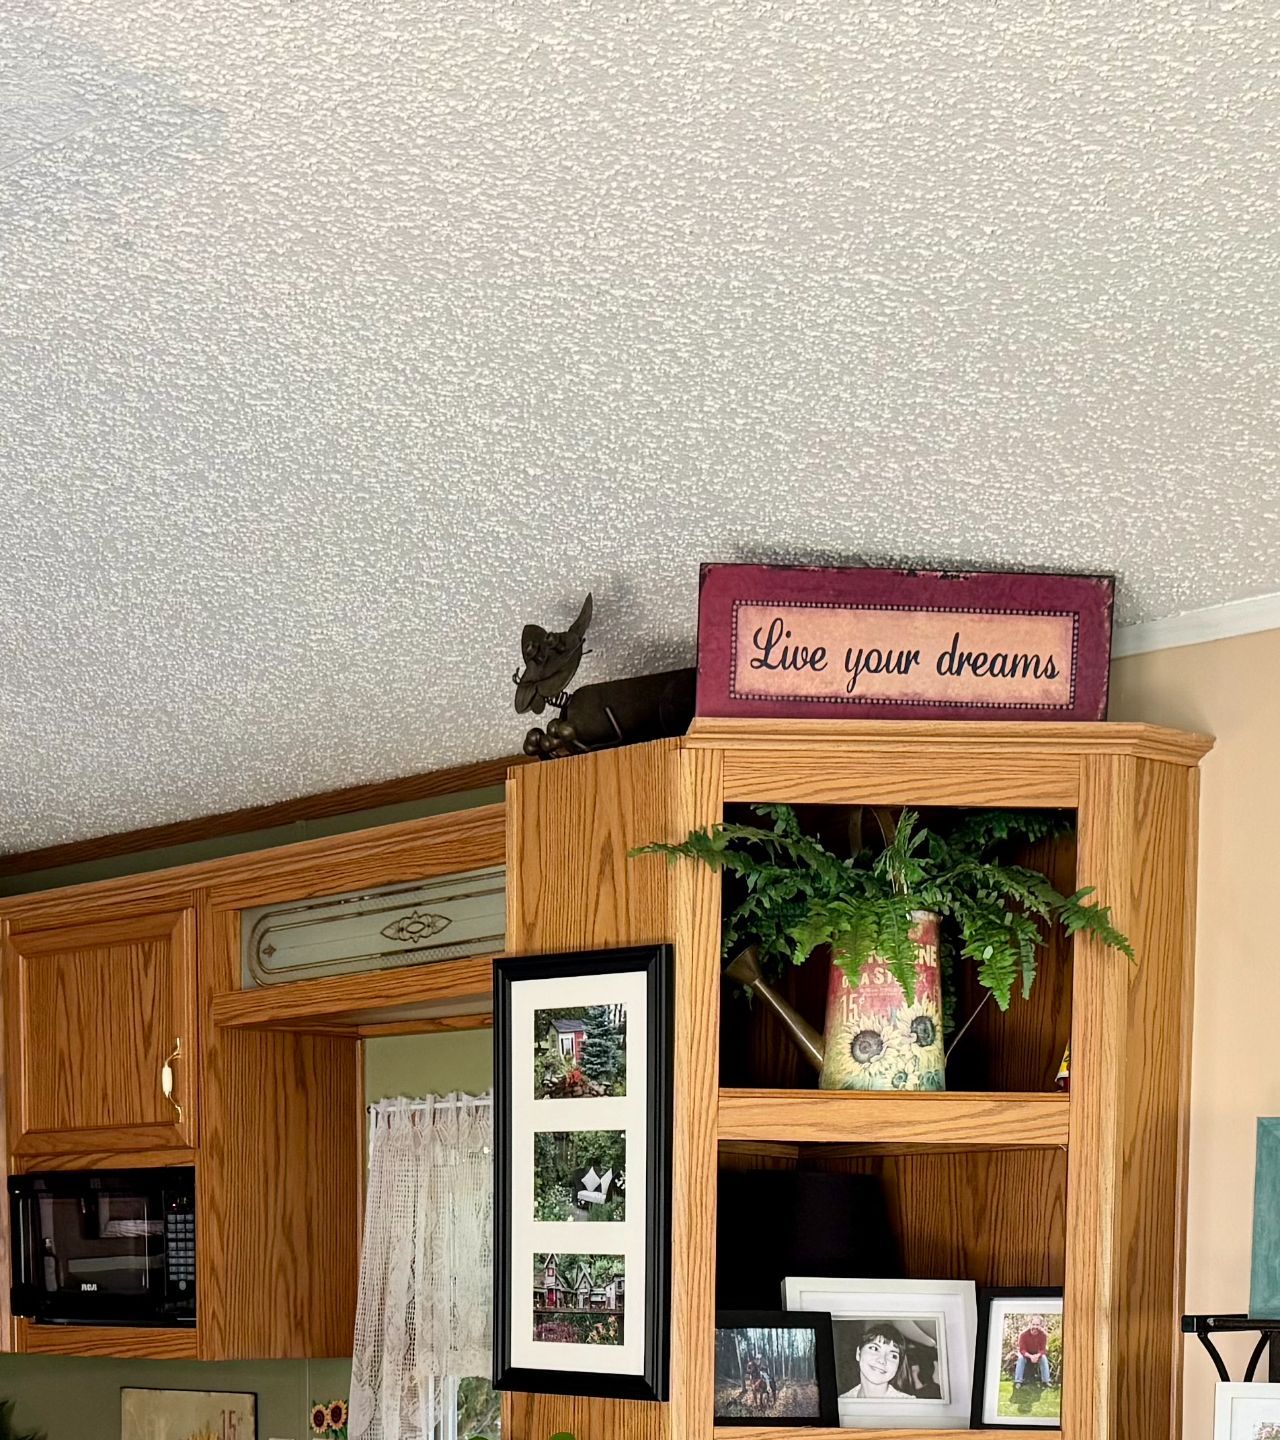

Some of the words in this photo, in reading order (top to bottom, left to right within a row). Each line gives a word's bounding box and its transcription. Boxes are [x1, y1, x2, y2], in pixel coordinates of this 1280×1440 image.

[750, 617, 828, 672] Live
[844, 646, 920, 694] your
[936, 631, 1060, 680] dreams
[81, 1283, 98, 1292] RCA
